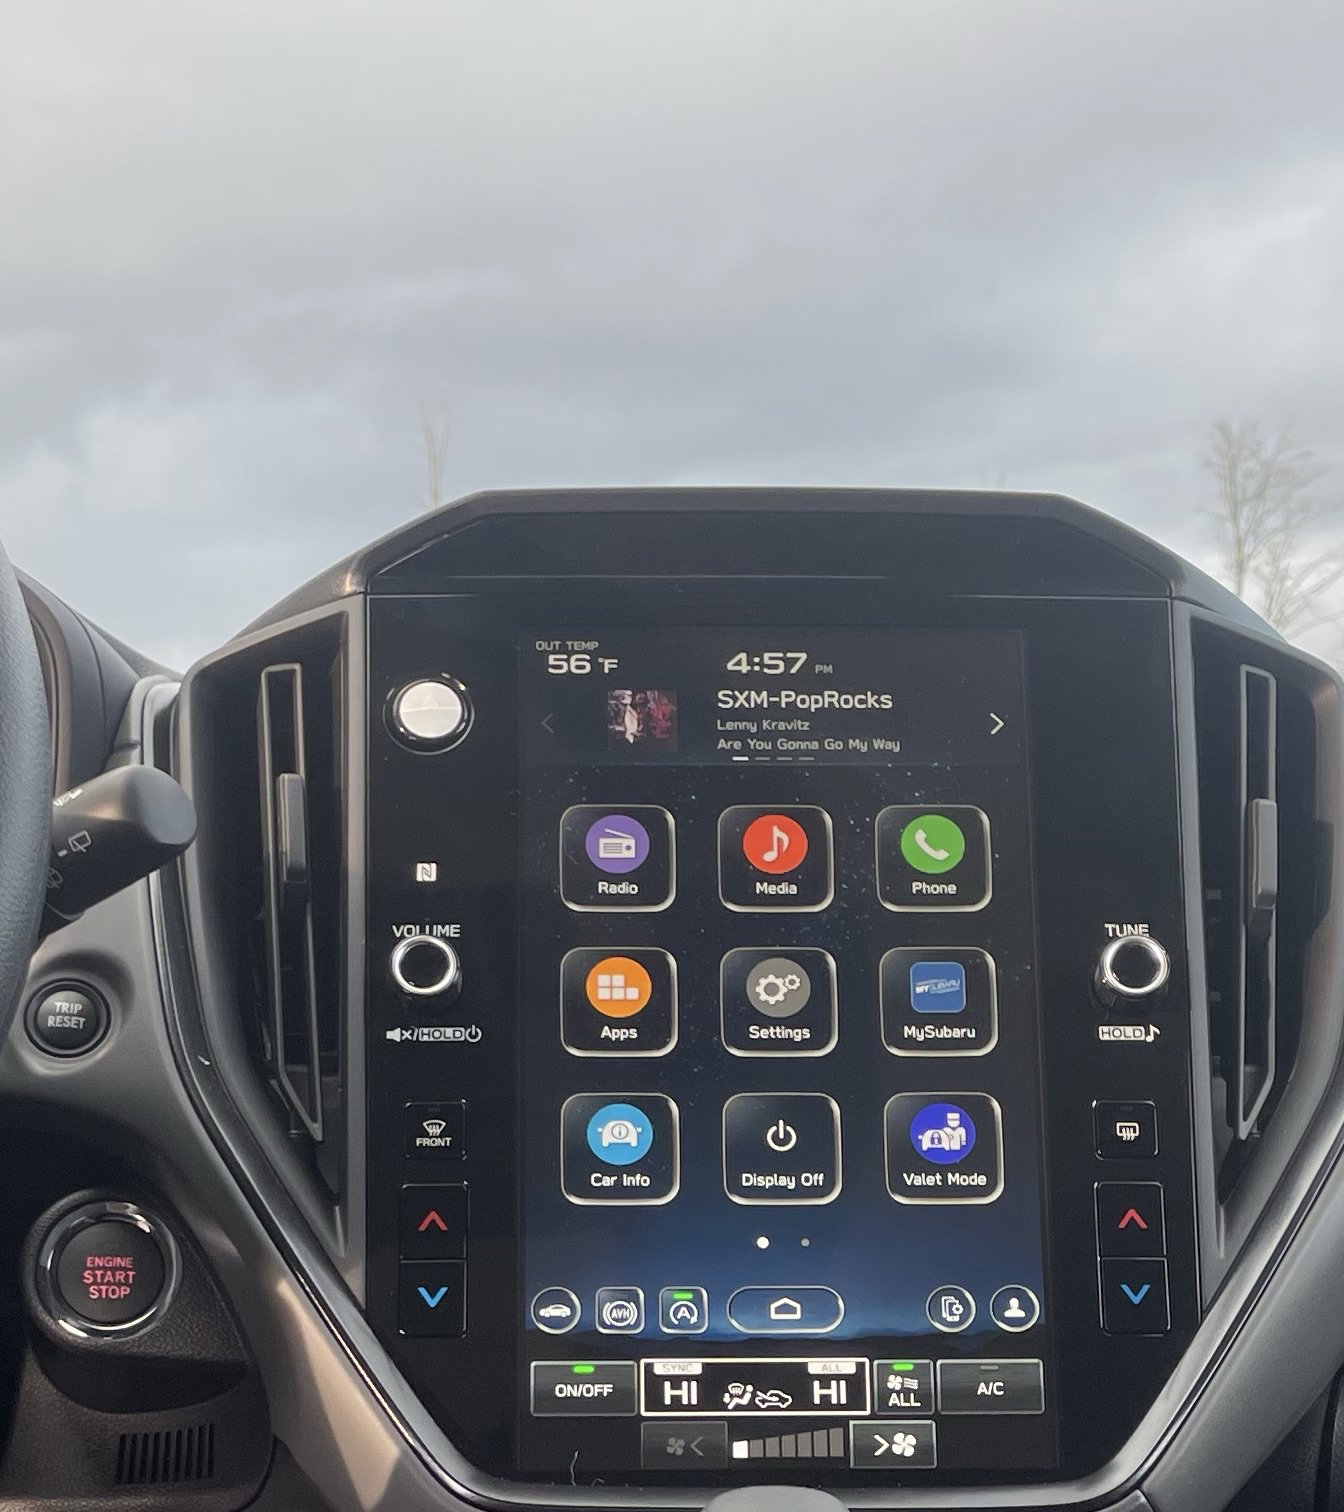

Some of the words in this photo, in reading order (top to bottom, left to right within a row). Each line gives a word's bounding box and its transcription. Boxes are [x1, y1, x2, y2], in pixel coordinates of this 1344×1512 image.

[535, 640, 561, 652] OUT
[566, 640, 599, 652] TEMP
[547, 653, 592, 675] 56
[725, 651, 808, 675] 4:57
[815, 664, 834, 675] PM
[716, 689, 894, 713] SXM-PopRocks
[716, 718, 758, 734] Lenny
[762, 718, 811, 731] Kravitz
[717, 738, 743, 751] Are
[747, 738, 773, 751] You
[777, 738, 819, 751] Gonna
[824, 738, 844, 751] Go
[848, 738, 868, 753] My
[872, 738, 901, 753] Way
[598, 881, 639, 896] Radio
[755, 881, 798, 896] Media
[911, 881, 957, 896] Phone
[391, 923, 461, 938] VOLUME
[1104, 922, 1150, 938] TUNE
[54, 1001, 83, 1015] TRIP
[47, 1014, 87, 1030] RESET
[420, 1028, 464, 1040] HOLD
[600, 1025, 638, 1041] Apps
[749, 1025, 811, 1041] Settings
[903, 1025, 976, 1041] MySubaru
[1100, 1027, 1144, 1039] HOLD
[415, 1137, 452, 1148] FRONT
[589, 1173, 619, 1188] Car
[622, 1173, 651, 1188] Info
[741, 1173, 798, 1191] Display
[801, 1173, 825, 1188] Off
[902, 1173, 944, 1188] Valet
[947, 1173, 988, 1188] Mode
[86, 1255, 134, 1269] ENGINE
[82, 1270, 137, 1285] START
[88, 1285, 131, 1299] STOP
[610, 1308, 631, 1320] AVH
[662, 1363, 694, 1373] SYNC
[821, 1363, 843, 1373] ALL
[554, 1383, 614, 1398] ON/OFF
[663, 1380, 698, 1405] HI
[813, 1380, 847, 1405] HI
[977, 1382, 1005, 1397] A/C
[888, 1392, 921, 1408] ALL
